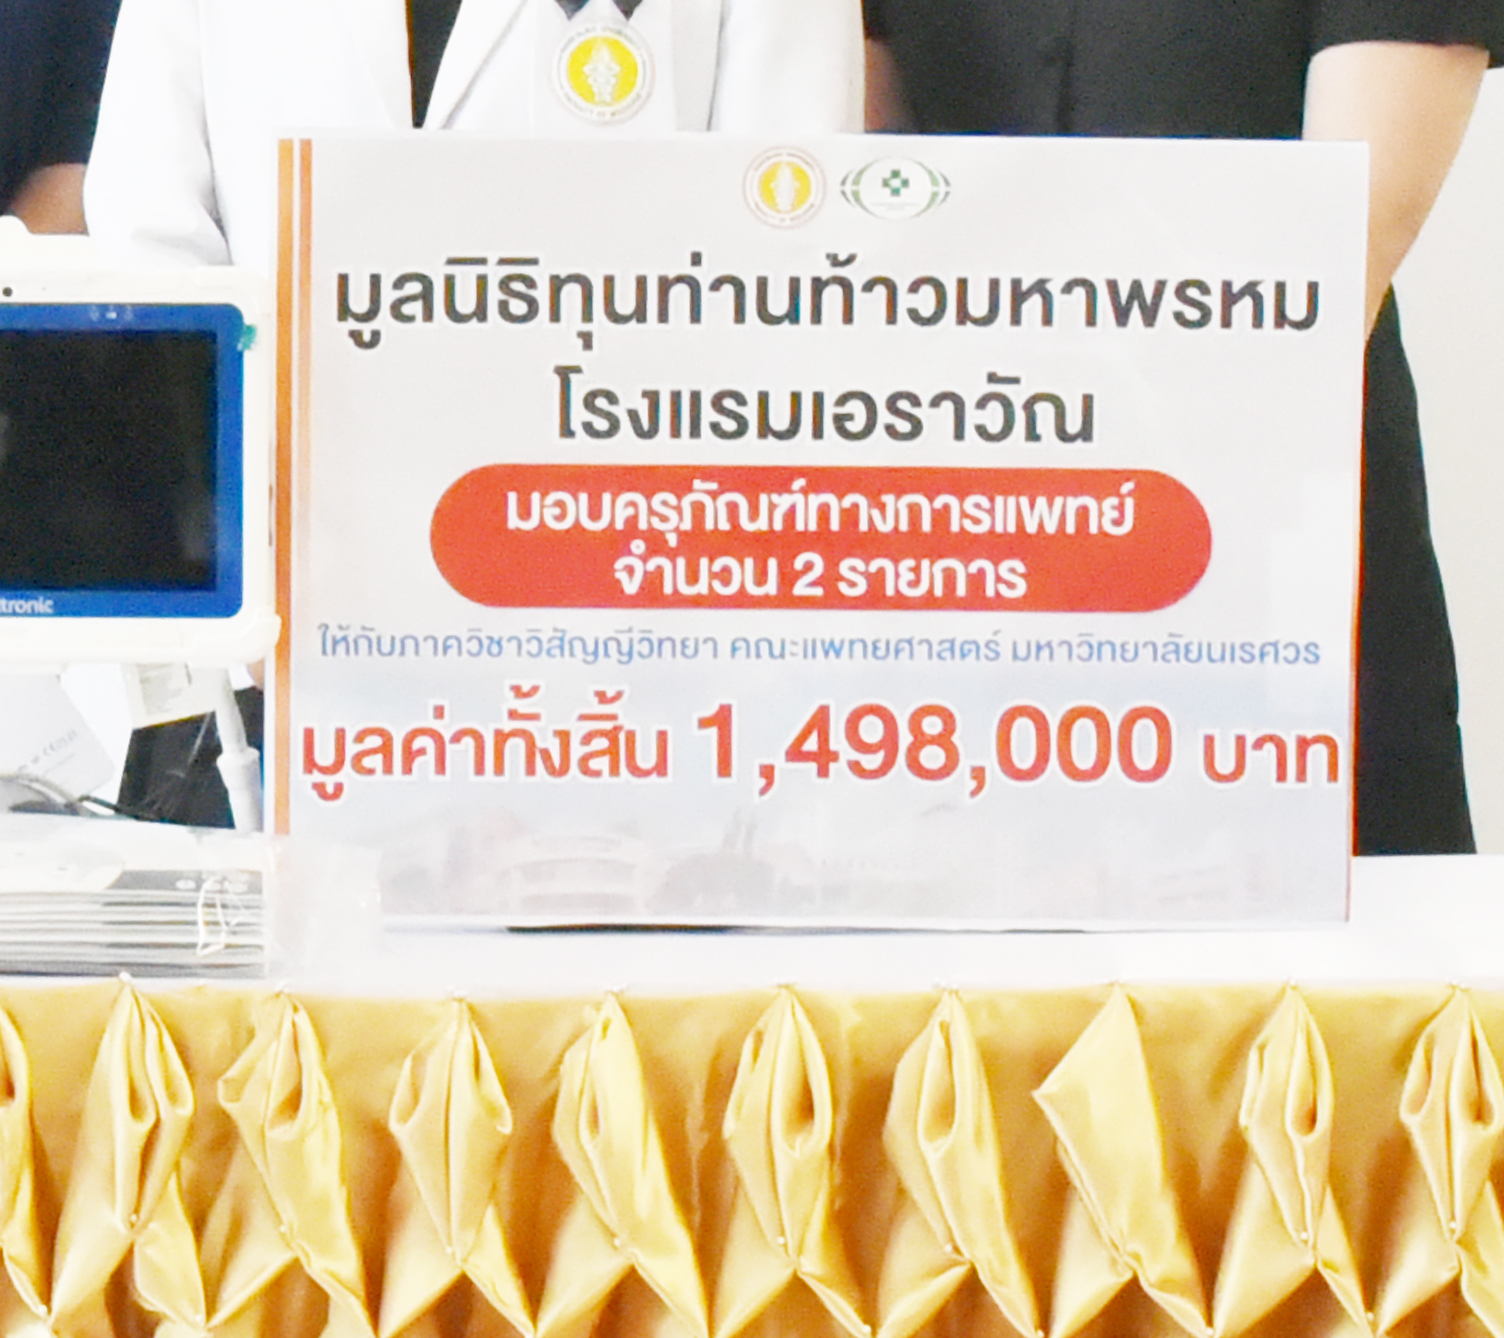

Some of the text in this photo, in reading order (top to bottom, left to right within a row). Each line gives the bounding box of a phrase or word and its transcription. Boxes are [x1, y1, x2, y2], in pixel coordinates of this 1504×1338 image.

[336, 251, 1320, 351] มูลนิธิทุนท่านท้าวมหาพรหม
[554, 365, 1094, 443] โรงแรมเอราวัณ
[506, 477, 1136, 548] มอบครุภัณฑ์ทางการแพทย์
[613, 539, 1028, 599] จำนวน 2 รายการ
[729, 629, 1002, 661] คณะแพทยศาสตร์
[1011, 632, 1321, 665] มหาวิทยาลัยนเรศวร
[302, 685, 1340, 801] มูลค่าทั้งสิ้น 1,498,000 บาท
